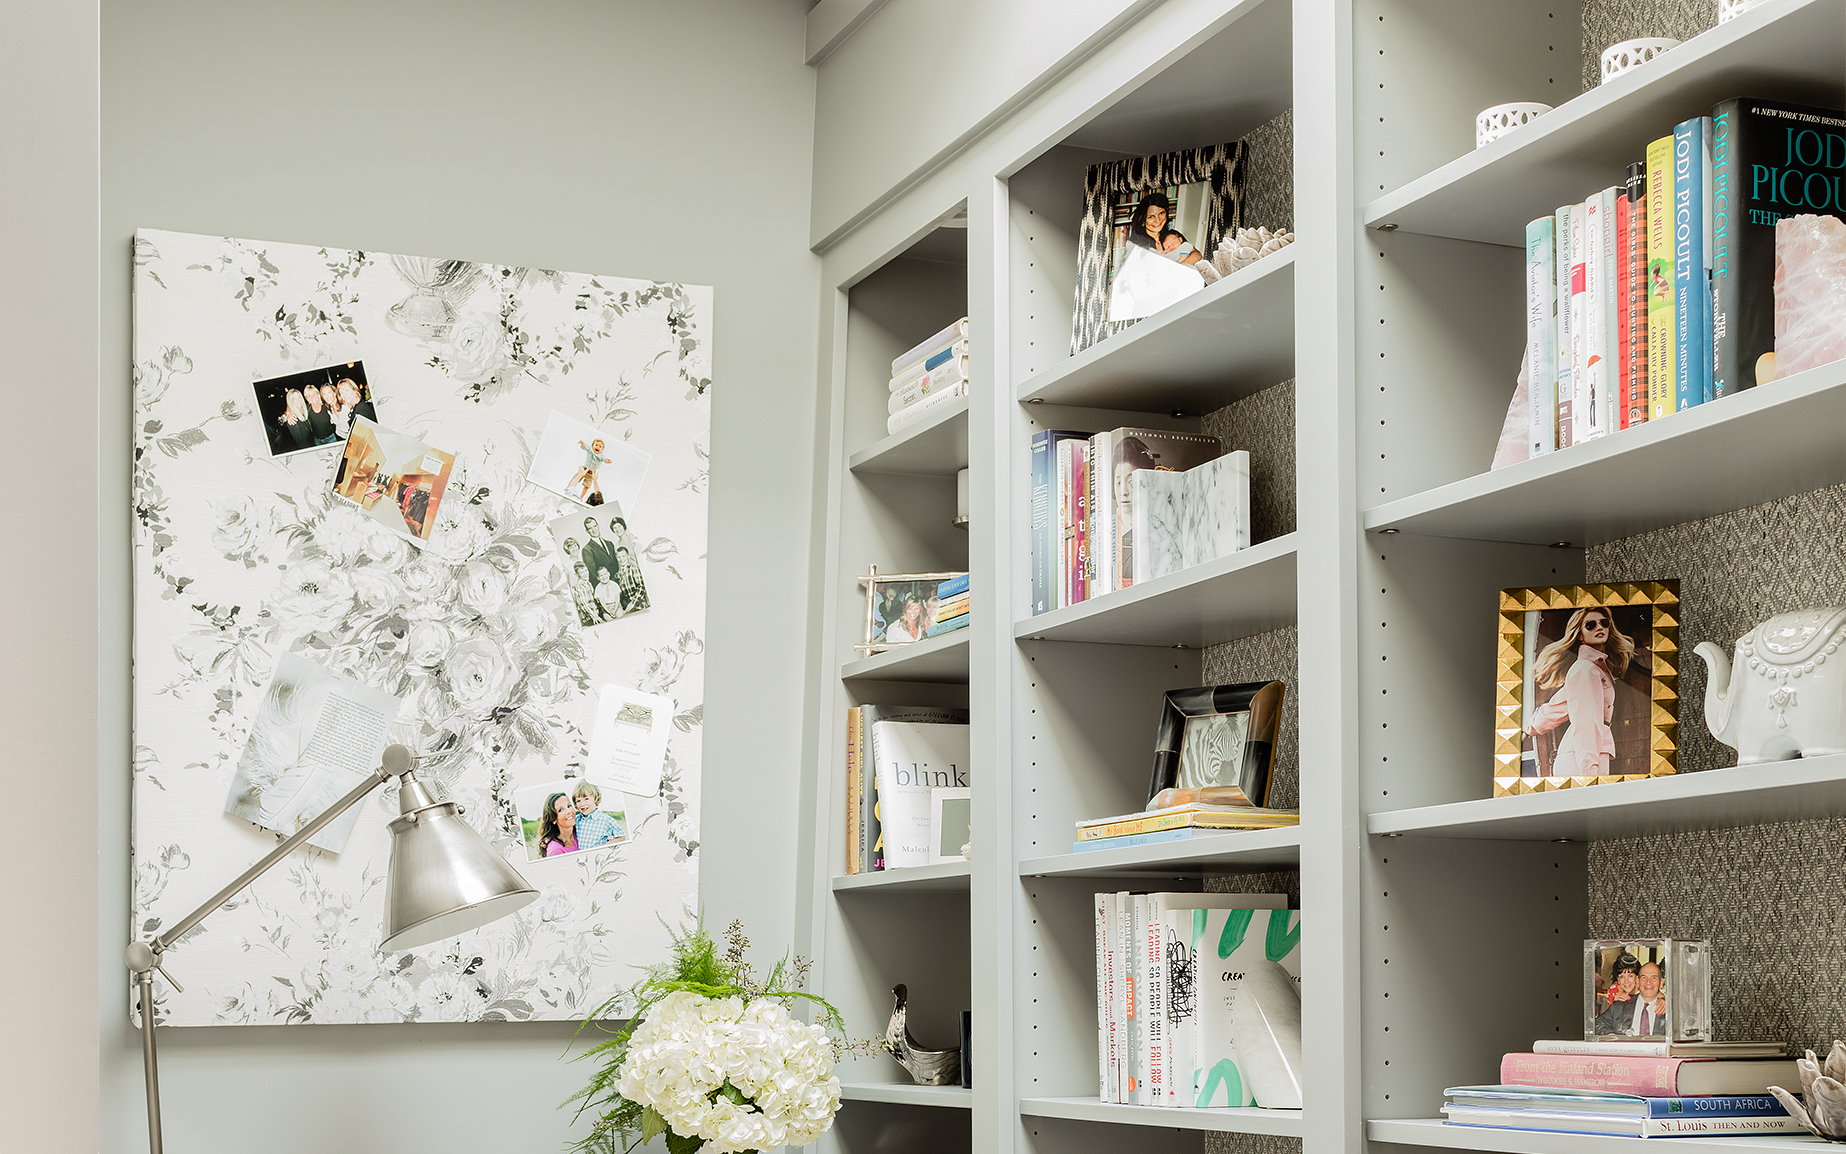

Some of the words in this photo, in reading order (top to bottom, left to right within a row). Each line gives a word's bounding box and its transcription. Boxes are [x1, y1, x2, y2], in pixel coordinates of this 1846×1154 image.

[1760, 108, 1778, 118] NEW
[1778, 111, 1798, 120] YORK
[1798, 113, 1820, 124] TIMES
[1821, 117, 1846, 128] BESTSE
[1713, 111, 1729, 172] JODI
[1784, 127, 1846, 169] JOD
[1676, 130, 1692, 183] JODI
[1652, 169, 1662, 215] REBECCA
[1751, 164, 1846, 213] PICOU
[1603, 205, 1613, 258] shopgirl
[1653, 216, 1662, 250] WELLS
[1677, 187, 1690, 280] PICOULT
[1713, 172, 1728, 278] PICOULT
[1531, 236, 1542, 257] The
[1562, 252, 1568, 263] of
[1530, 261, 1542, 303] Aviator's
[1529, 302, 1542, 328] Wife
[1562, 295, 1570, 335] wallflower
[1679, 286, 1688, 342] NINETEEN
[1659, 327, 1667, 372] CROWNING
[1679, 343, 1688, 392] MINUTES
[1660, 373, 1668, 399] GLORY
[1129, 431, 1167, 439] NATIONAL
[1171, 435, 1216, 444] BESTSELLER
[1033, 483, 1048, 530] KENNEDYS
[892, 761, 969, 788] blink
[902, 845, 930, 853] Malcol
[1119, 943, 1124, 954] IN
[1126, 961, 1132, 974] OF
[1149, 966, 1155, 979] SO
[1155, 965, 1161, 979] SO
[1221, 971, 1245, 982] CREA
[1135, 940, 1143, 1052] INNOVATION
[1138, 1058, 1143, 1070] X
[1516, 1059, 1539, 1073] From
[1542, 1060, 1556, 1074] the
[1558, 1060, 1594, 1075] Finland
[1597, 1062, 1630, 1076] Station
[1537, 1076, 1567, 1086] THEODORE
[1574, 1077, 1606, 1087] HAMEROW
[1694, 1099, 1731, 1111] SOUTH
[1735, 1099, 1772, 1110] AFRICA
[1660, 1120, 1675, 1132] St.
[1677, 1120, 1708, 1131] Louis
